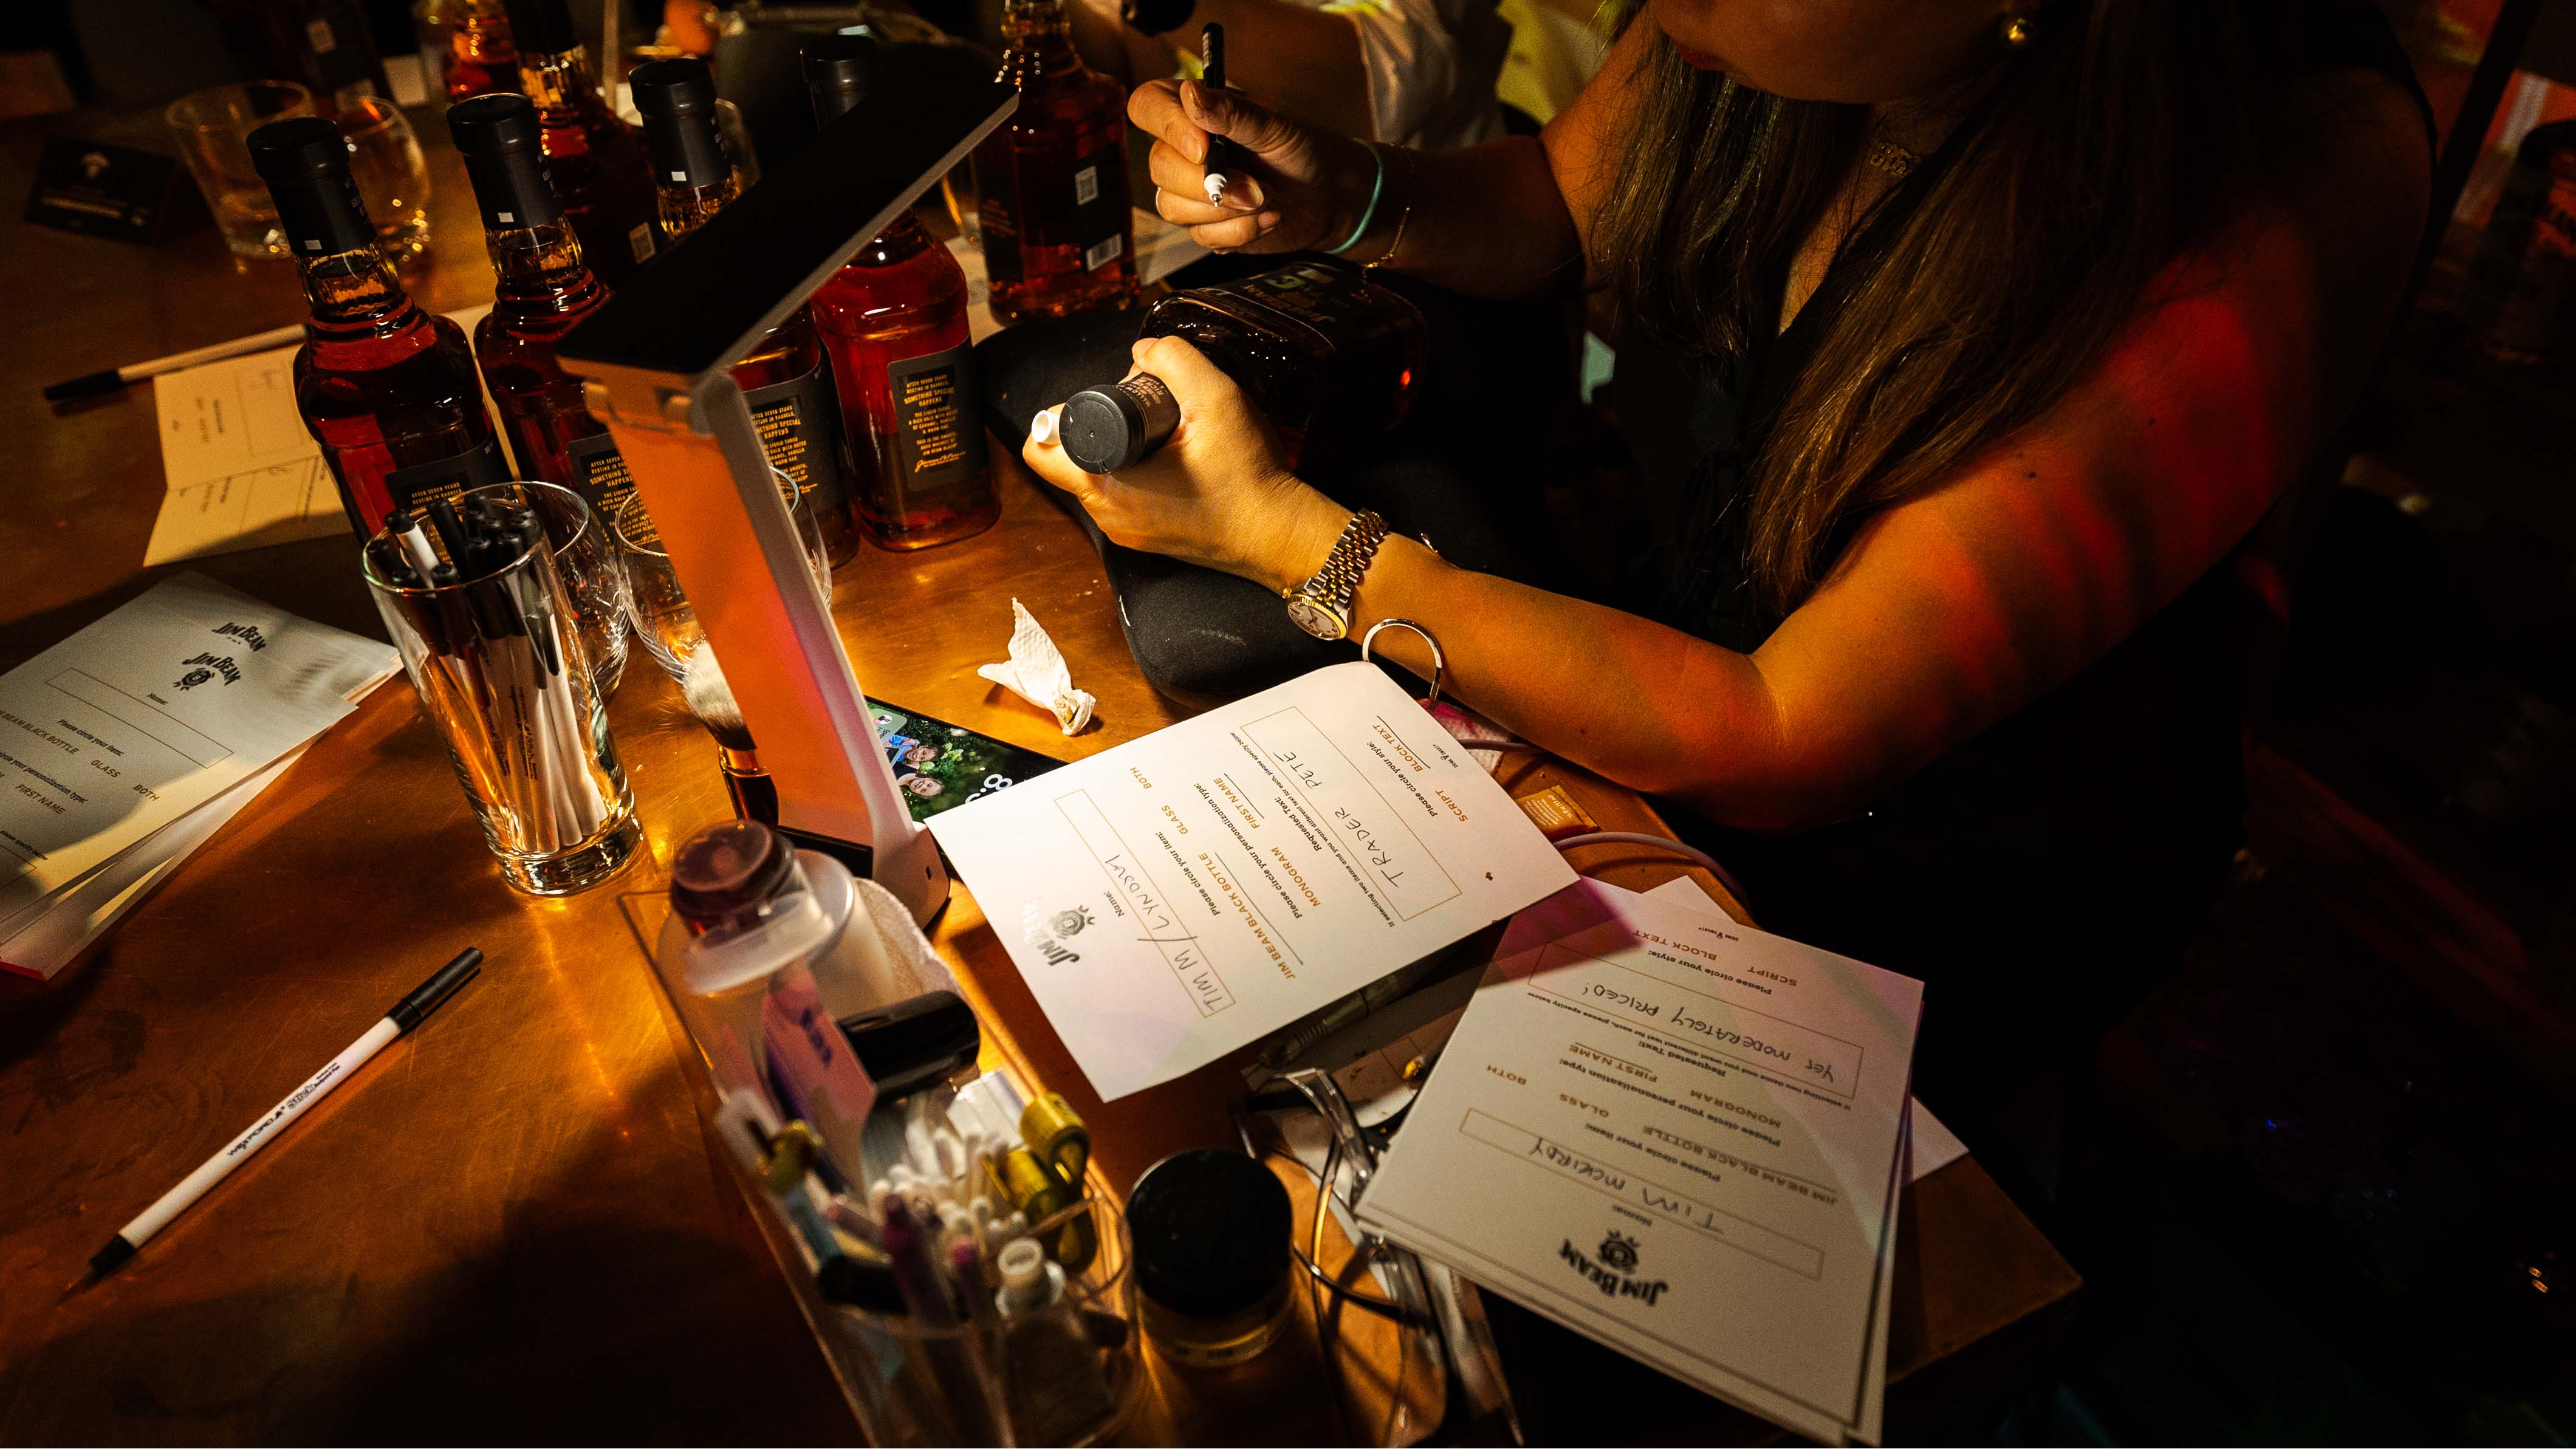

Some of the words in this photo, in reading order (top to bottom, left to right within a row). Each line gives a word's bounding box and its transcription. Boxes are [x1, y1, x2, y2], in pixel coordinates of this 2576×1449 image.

[903, 391, 934, 405] SOMETHING
[933, 387, 954, 396] SPECIAL
[1151, 382, 1165, 397] RICH
[917, 396, 942, 407] HAPPENS
[779, 418, 801, 427] SPECIAL
[764, 427, 789, 439] HAPPENS
[589, 470, 622, 485] SOMETHING
[591, 465, 611, 474] RESTING
[444, 482, 461, 490] YEARS
[606, 474, 633, 487] HAPPENS
[211, 622, 246, 635] JIM
[238, 625, 266, 652] BEAM
[182, 653, 221, 666] JIM
[211, 656, 241, 687] BEAM
[57, 719, 78, 731] Please
[76, 730, 94, 740] circle
[91, 738, 109, 747] your
[106, 745, 125, 756] item:
[1230, 733, 1244, 745] below
[1372, 725, 1395, 745] TEXT
[1242, 745, 1259, 761] specify
[1366, 742, 1385, 758] style:
[1394, 745, 1423, 772] BLOCK
[21, 723, 50, 738] BLACK
[46, 735, 80, 754] BOTTLE
[91, 759, 121, 778] GLASS
[132, 784, 159, 801] BOTH
[1257, 761, 1273, 776] please
[1273, 752, 1323, 789] PETE
[1383, 759, 1401, 774] your
[10, 759, 27, 769] your
[22, 767, 72, 795] personalization
[69, 792, 88, 804] type:
[1130, 767, 1153, 789] BOTH
[1272, 775, 1284, 789] each,
[1398, 773, 1416, 792] circle
[15, 784, 42, 799] FIRST
[38, 797, 66, 815] NAME
[1193, 784, 1210, 800] type:
[1213, 778, 1239, 803] NAME
[1275, 797, 1291, 815] Text:
[1288, 796, 1298, 806] text
[1415, 792, 1438, 817] Please
[1435, 790, 1468, 822] SCRIPT
[1162, 805, 1188, 835] GLASS
[1208, 799, 1254, 851] personalization
[1235, 804, 1260, 829] FIRST
[1297, 806, 1317, 827] different
[1155, 832, 1173, 849] item:
[1289, 814, 1322, 851] Requested
[1315, 827, 1328, 842] want
[1327, 842, 1339, 854] you
[1335, 807, 1404, 888] TRADER
[1170, 850, 1187, 867] your
[1249, 852, 1267, 869] your
[1335, 853, 1347, 865] and
[1183, 868, 1201, 888] circle
[1199, 853, 1232, 892] BOTTLE
[1264, 869, 1282, 891] circle
[1271, 847, 1321, 907] MONOGRAM
[1346, 865, 1360, 882] items
[1358, 882, 1369, 894] two
[1106, 893, 1125, 917] Name:
[1199, 889, 1221, 916] Please
[1228, 892, 1258, 928] BLACK
[1280, 891, 1303, 919] Please
[1368, 894, 1391, 921] selecting
[1254, 928, 1281, 961] BEAM
[1632, 928, 1669, 945] TEXT
[1036, 939, 1080, 967] JIM
[1174, 950, 1197, 970] M
[1648, 950, 1676, 962] style:
[1673, 942, 1717, 961] BLOCK
[1278, 962, 1296, 979] JIM
[1678, 960, 1702, 971] your
[1704, 968, 1734, 981] circle
[1736, 979, 1772, 995] Please
[1748, 967, 1798, 987] SCRIPT
[1193, 972, 1233, 1016] TIM
[1570, 1045, 1612, 1066] NAME
[1639, 1041, 1665, 1055] Text:
[1560, 1059, 1586, 1074] type:
[1616, 1063, 1657, 1083] FIRST
[1668, 1051, 1726, 1077] Requested
[1487, 1065, 1527, 1085] BOTH
[1589, 1070, 1676, 1106] personalization
[1560, 1094, 1609, 1117] GLASS
[1678, 1104, 1704, 1117] your
[1690, 1090, 1781, 1128] MONOGRAM
[1586, 1124, 1614, 1140] item:
[1707, 1114, 1739, 1130] circle
[1616, 1136, 1643, 1150] your
[1643, 1126, 1703, 1155] BOTTLE
[1741, 1127, 1781, 1147] Please
[1646, 1148, 1678, 1164] circle
[1708, 1151, 1759, 1176] BLACK
[1680, 1162, 1721, 1182] Please
[1762, 1173, 1809, 1195] BEAM
[1812, 1191, 1837, 1205] JIM
[1613, 1206, 1652, 1227] Name:
[1558, 1237, 1619, 1298] BEAM
[1620, 1279, 1669, 1306] JIM
